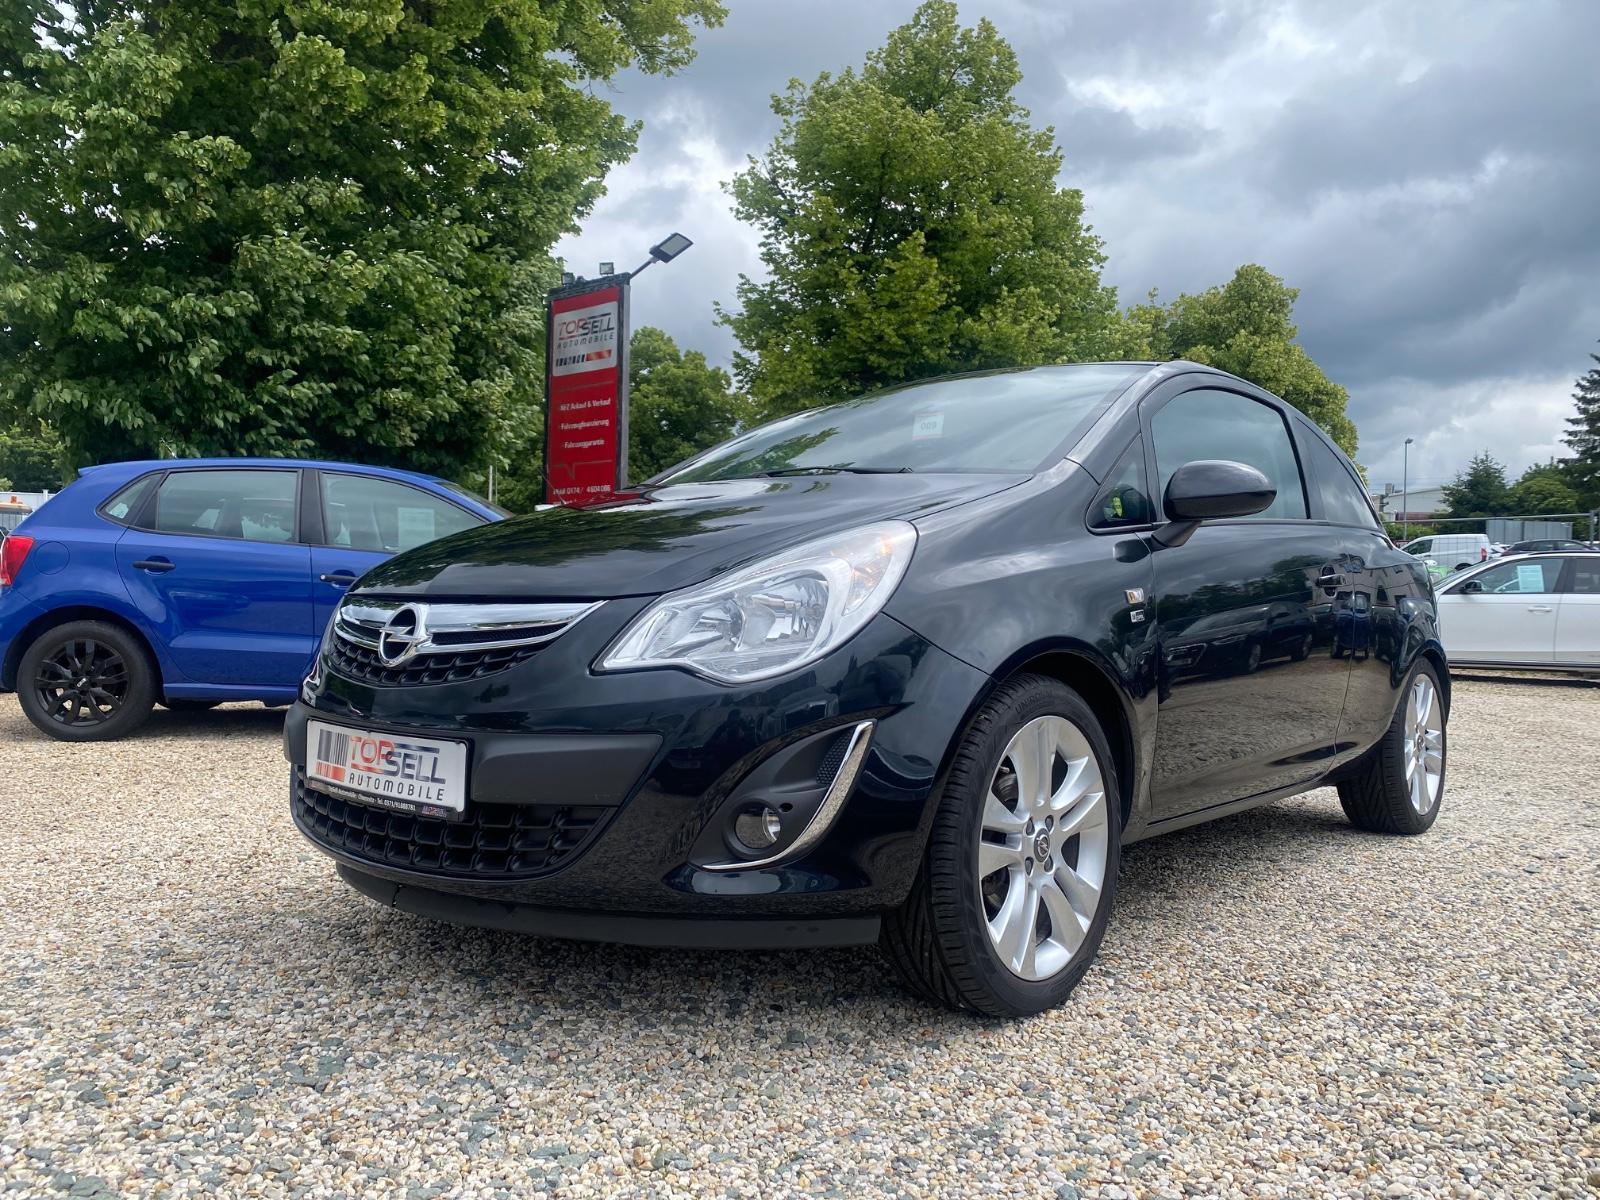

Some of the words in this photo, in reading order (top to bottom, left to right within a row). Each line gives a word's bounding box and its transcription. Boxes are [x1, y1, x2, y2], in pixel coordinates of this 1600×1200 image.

[557, 332, 614, 350] AUTOMOBILE
[350, 735, 447, 785] TOPSELL
[348, 772, 446, 801] AUTOMOBILE
